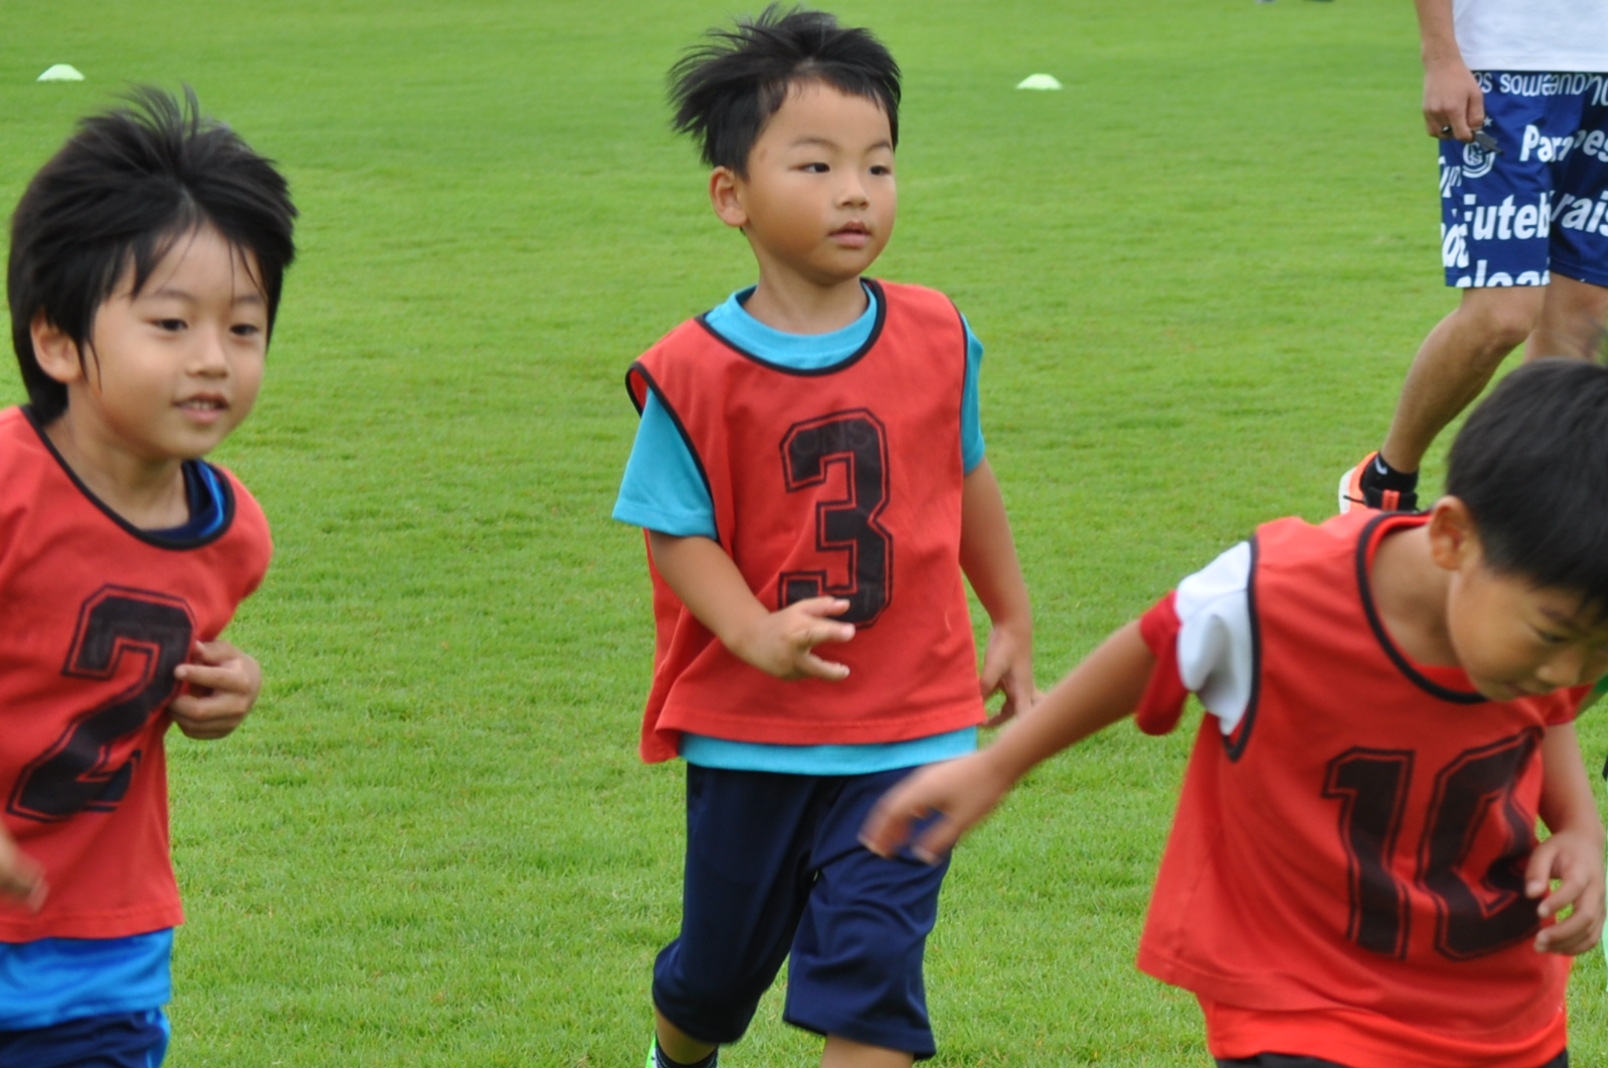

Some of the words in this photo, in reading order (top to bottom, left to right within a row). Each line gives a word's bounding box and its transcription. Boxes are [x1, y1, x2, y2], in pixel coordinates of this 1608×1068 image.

[778, 408, 892, 631] 3
[7, 582, 197, 823] 2
[1321, 726, 1545, 962] 10
